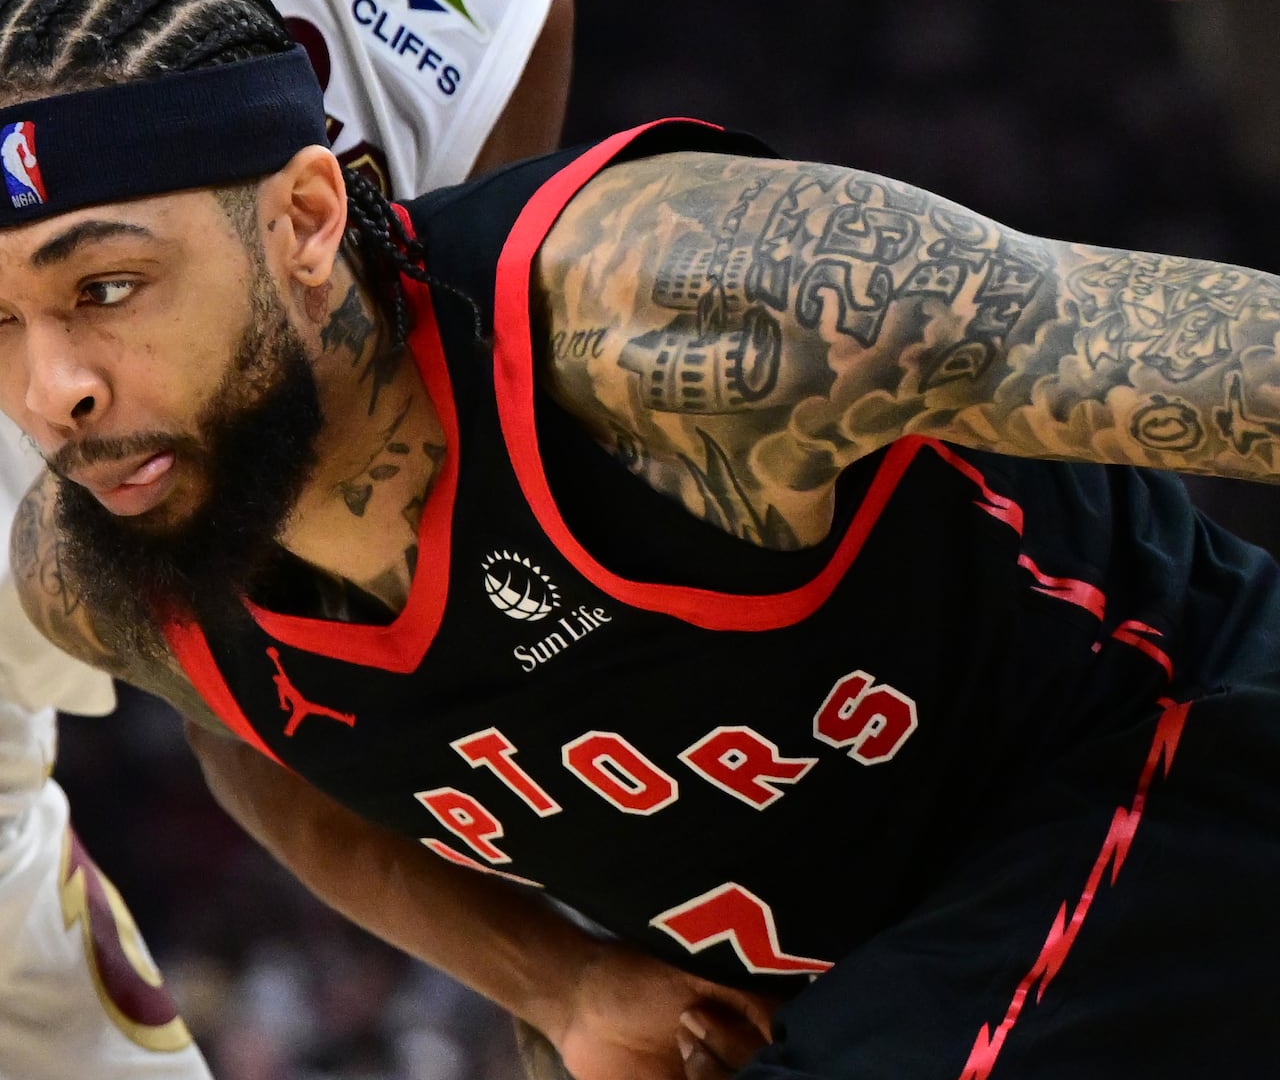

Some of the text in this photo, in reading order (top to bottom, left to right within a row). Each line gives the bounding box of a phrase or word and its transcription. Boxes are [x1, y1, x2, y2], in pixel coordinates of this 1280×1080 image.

[11, 191, 38, 209] NBA
[513, 605, 613, 672] Sun Life
[414, 670, 918, 889] PTORS
